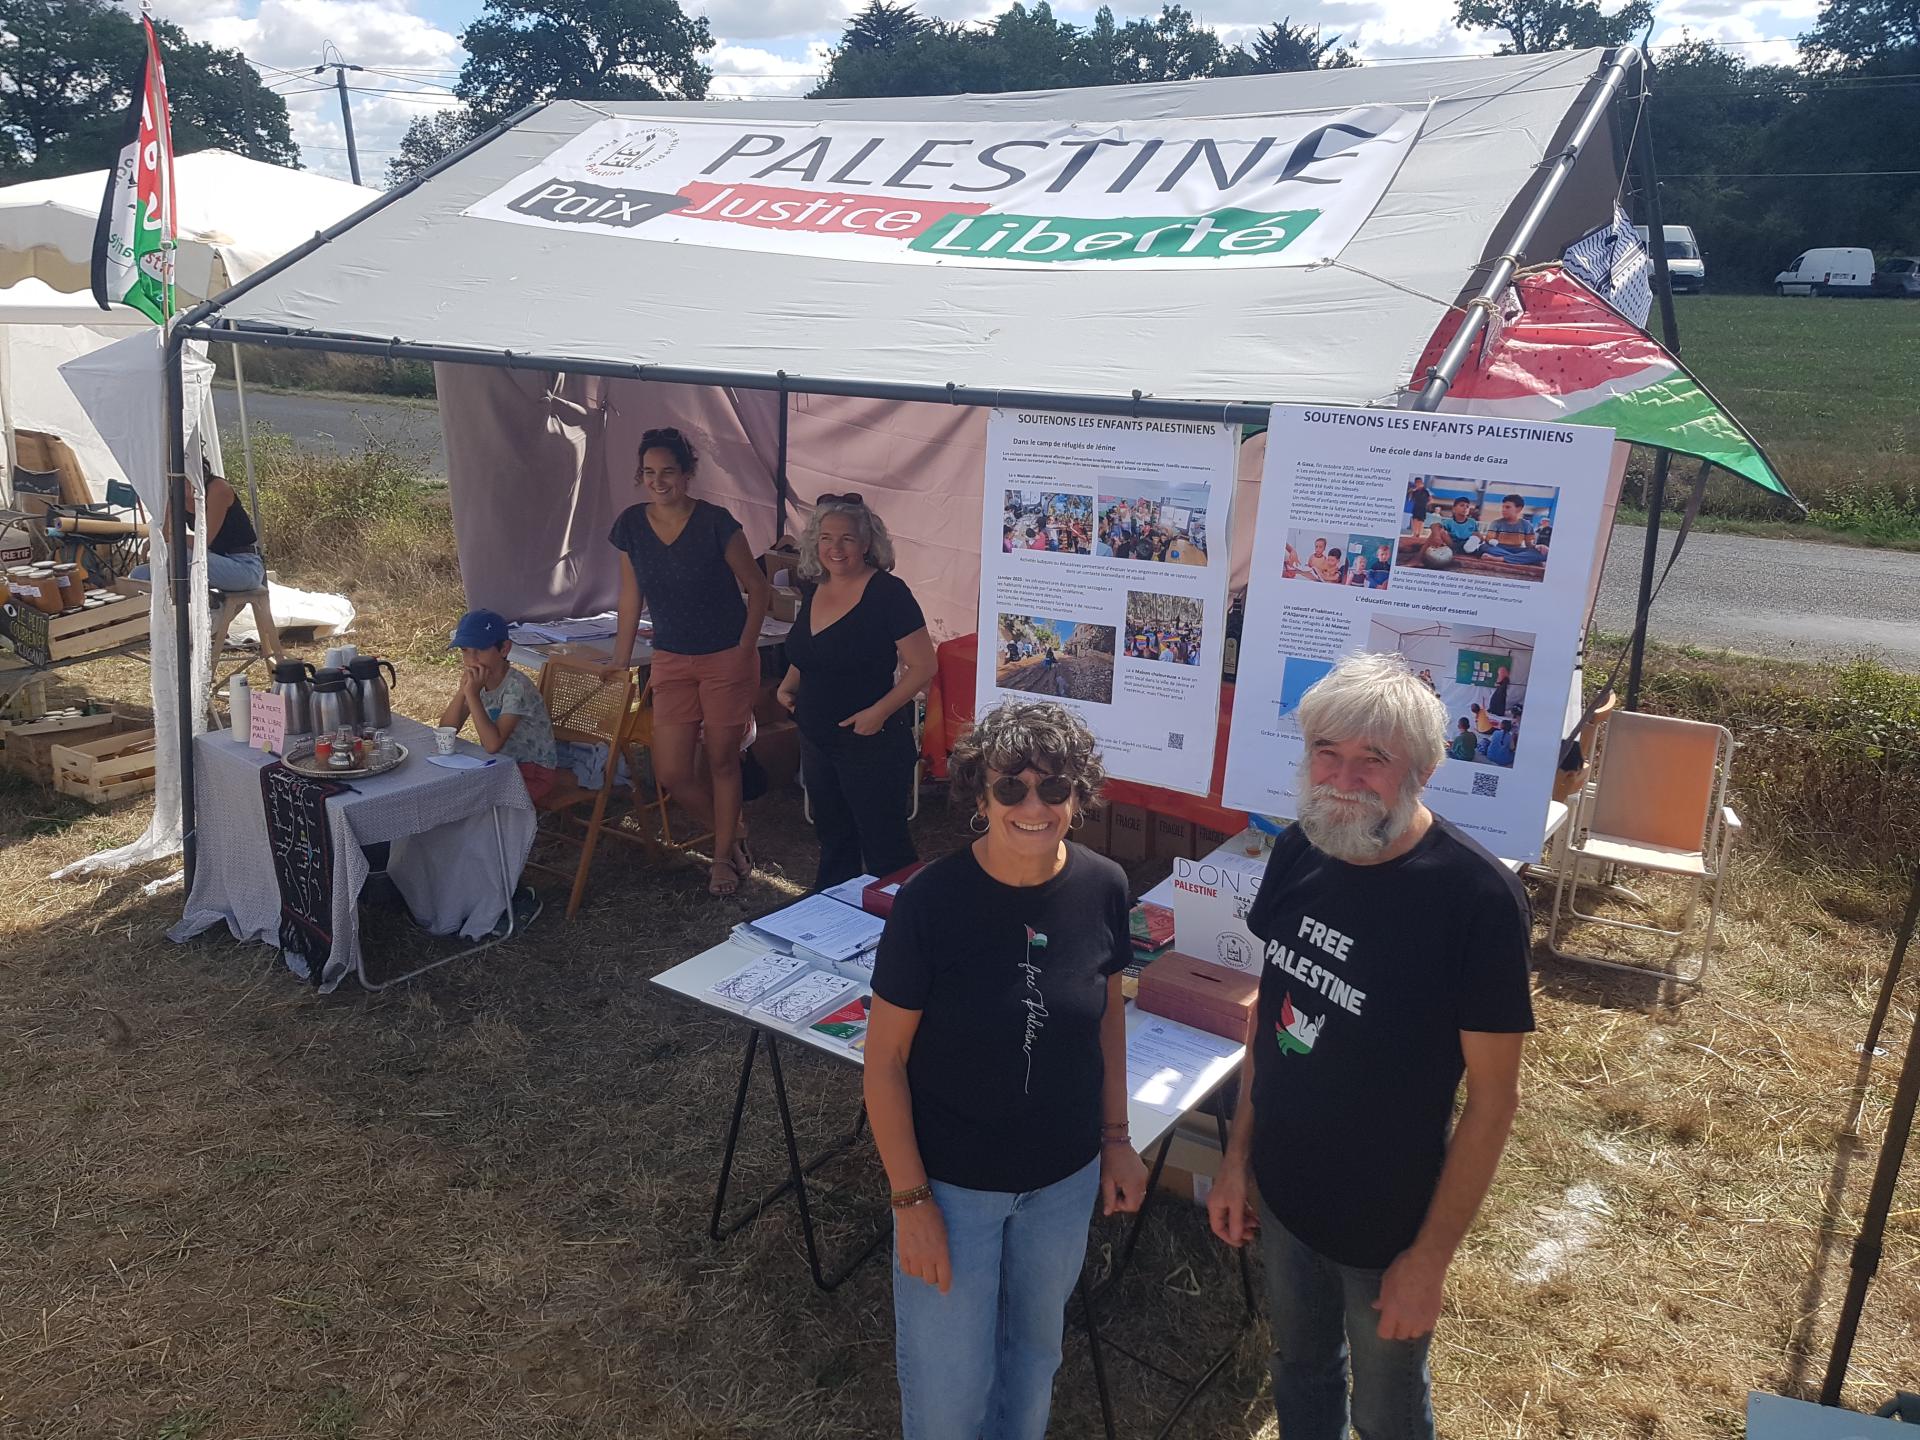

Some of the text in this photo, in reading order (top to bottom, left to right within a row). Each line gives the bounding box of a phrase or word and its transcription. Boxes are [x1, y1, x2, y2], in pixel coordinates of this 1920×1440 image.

[699, 123, 1380, 193] PALESTINE
[520, 184, 1294, 254] Paix Justice Liberté
[1018, 412, 1215, 436] SOUTENONS LES ENFANTS PALESTINIENS
[1303, 410, 1574, 443] SOUTENONS LES ENFANTS PALESTINIENS
[1013, 437, 1029, 445] Dans
[1036, 440, 1052, 448] camp
[1061, 440, 1084, 450] réfugiés
[1095, 442, 1115, 451] Jénine
[1369, 444, 1508, 465] Une école dans la bande de Gaza
[1354, 595, 1477, 617] L'éducation reste un objectif essentiel
[1116, 814, 1141, 831] FRAGILE
[1160, 821, 1184, 838] FRAGILE
[1174, 879, 1218, 898] PALESTINE
[1297, 915, 1354, 962] FREE
[1265, 939, 1366, 1016] PALESTINE
